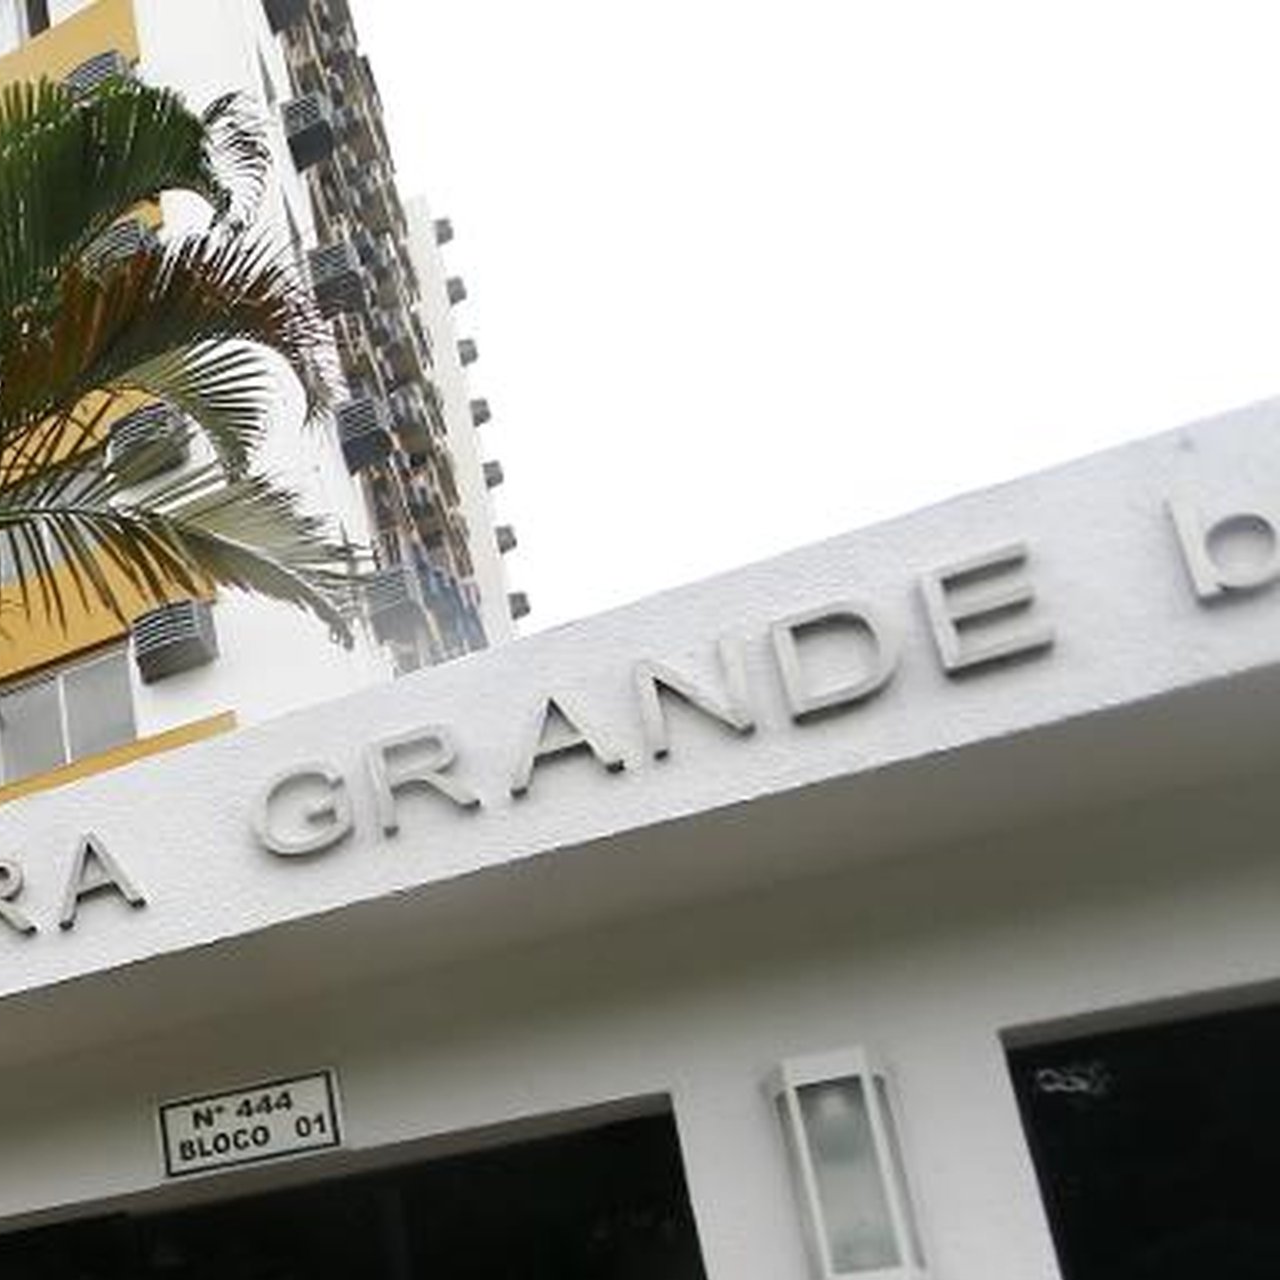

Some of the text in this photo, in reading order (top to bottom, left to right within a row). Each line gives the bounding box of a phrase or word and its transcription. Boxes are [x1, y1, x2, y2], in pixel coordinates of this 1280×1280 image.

[252, 540, 1054, 858] GRANDE
[236, 1091, 293, 1117] 444
[179, 1112, 327, 1161] BLOCO 01
